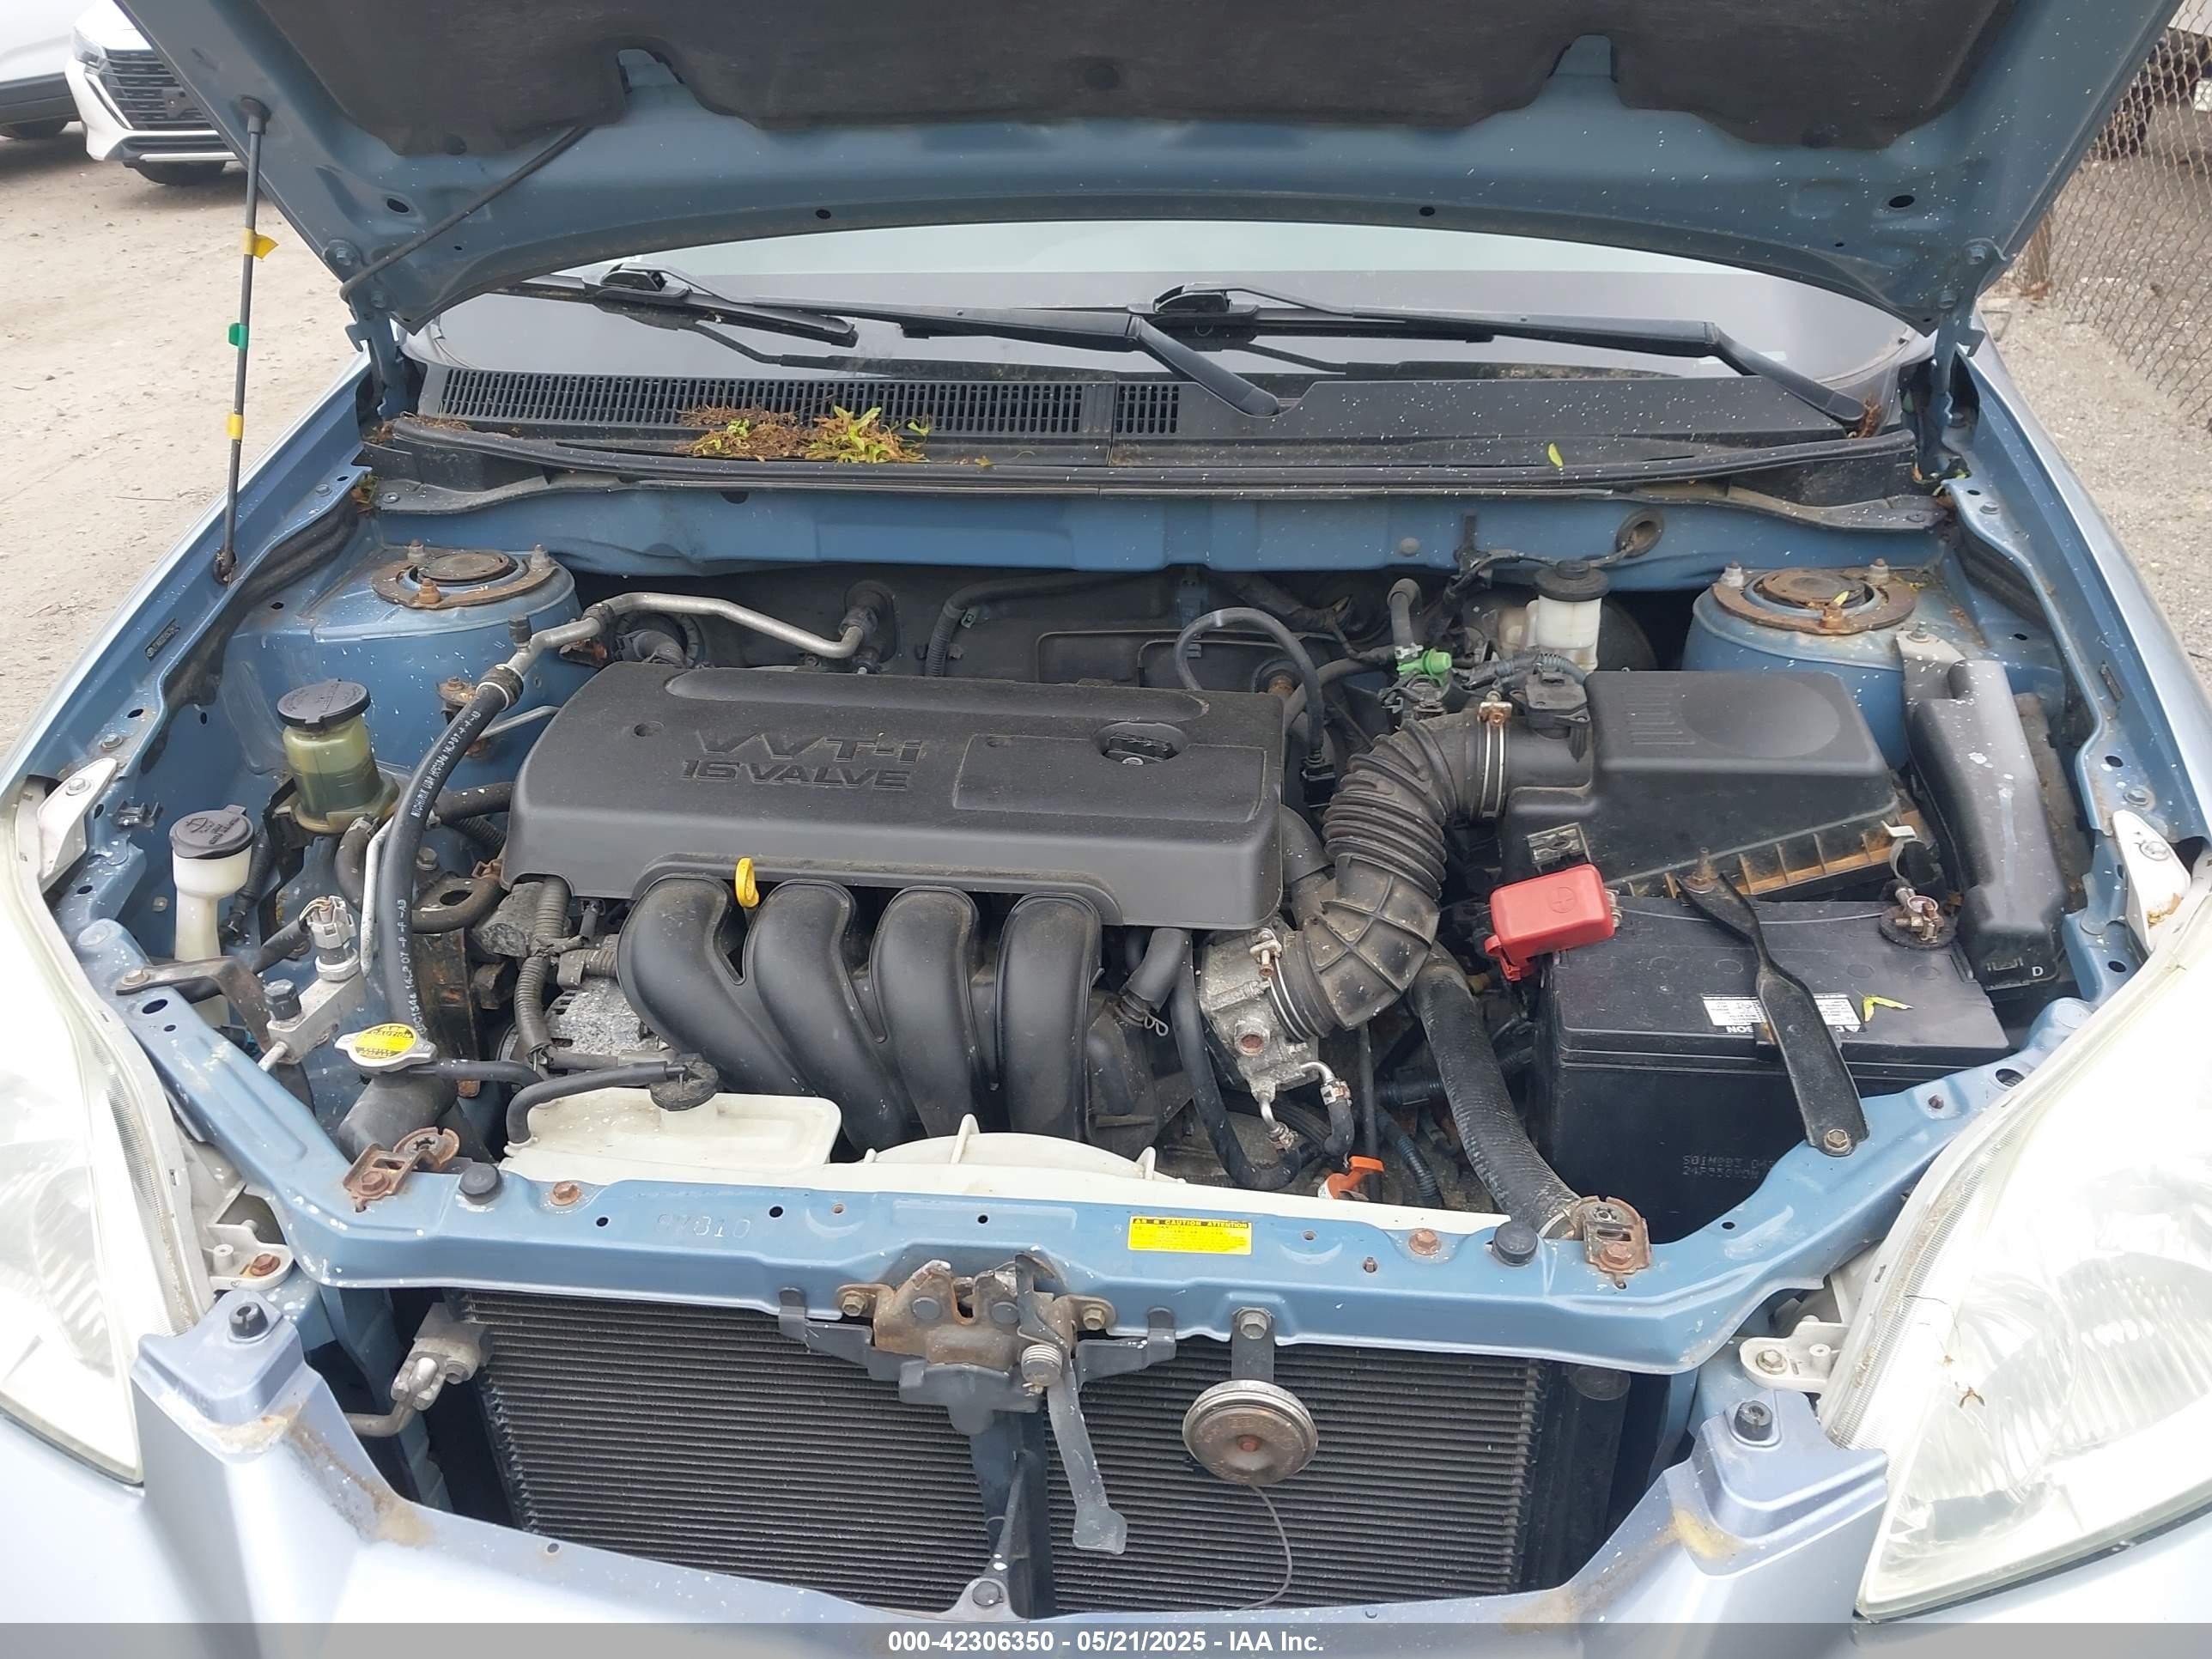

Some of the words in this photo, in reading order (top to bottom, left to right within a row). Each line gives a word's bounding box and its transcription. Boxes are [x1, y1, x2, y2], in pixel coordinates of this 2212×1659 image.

[2031, 966, 2044, 977] D
[370, 1030, 412, 1038] CAUTION
[1206, 1220, 1248, 1229] ATTENTION
